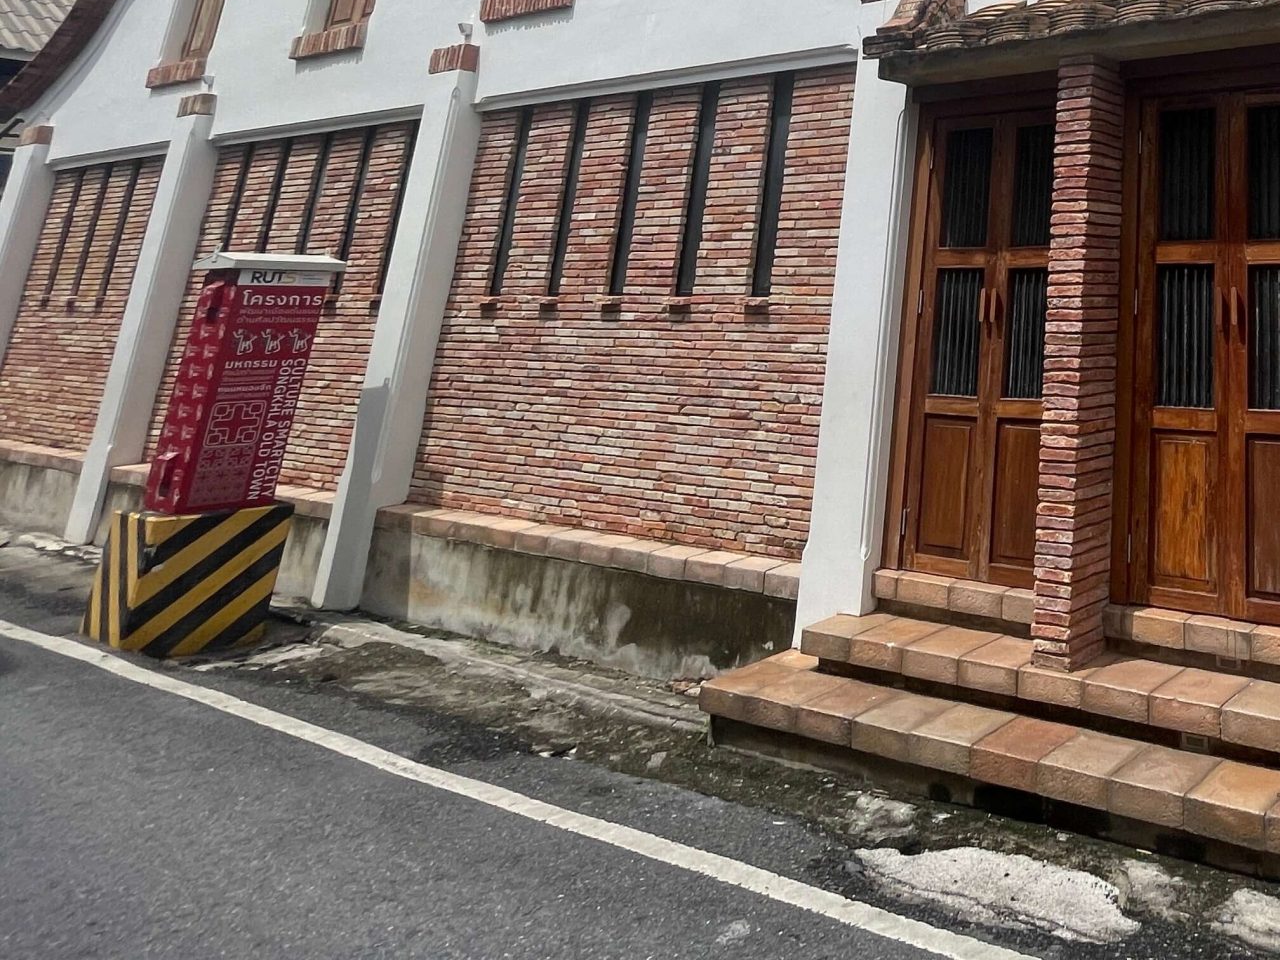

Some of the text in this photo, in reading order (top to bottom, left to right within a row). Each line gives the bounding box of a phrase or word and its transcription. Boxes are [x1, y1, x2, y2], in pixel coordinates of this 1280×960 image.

[242, 290, 322, 306] โครงการ
[281, 358, 306, 416] CULTURE
[246, 359, 293, 500] SONGKHLA OLD TOWN
